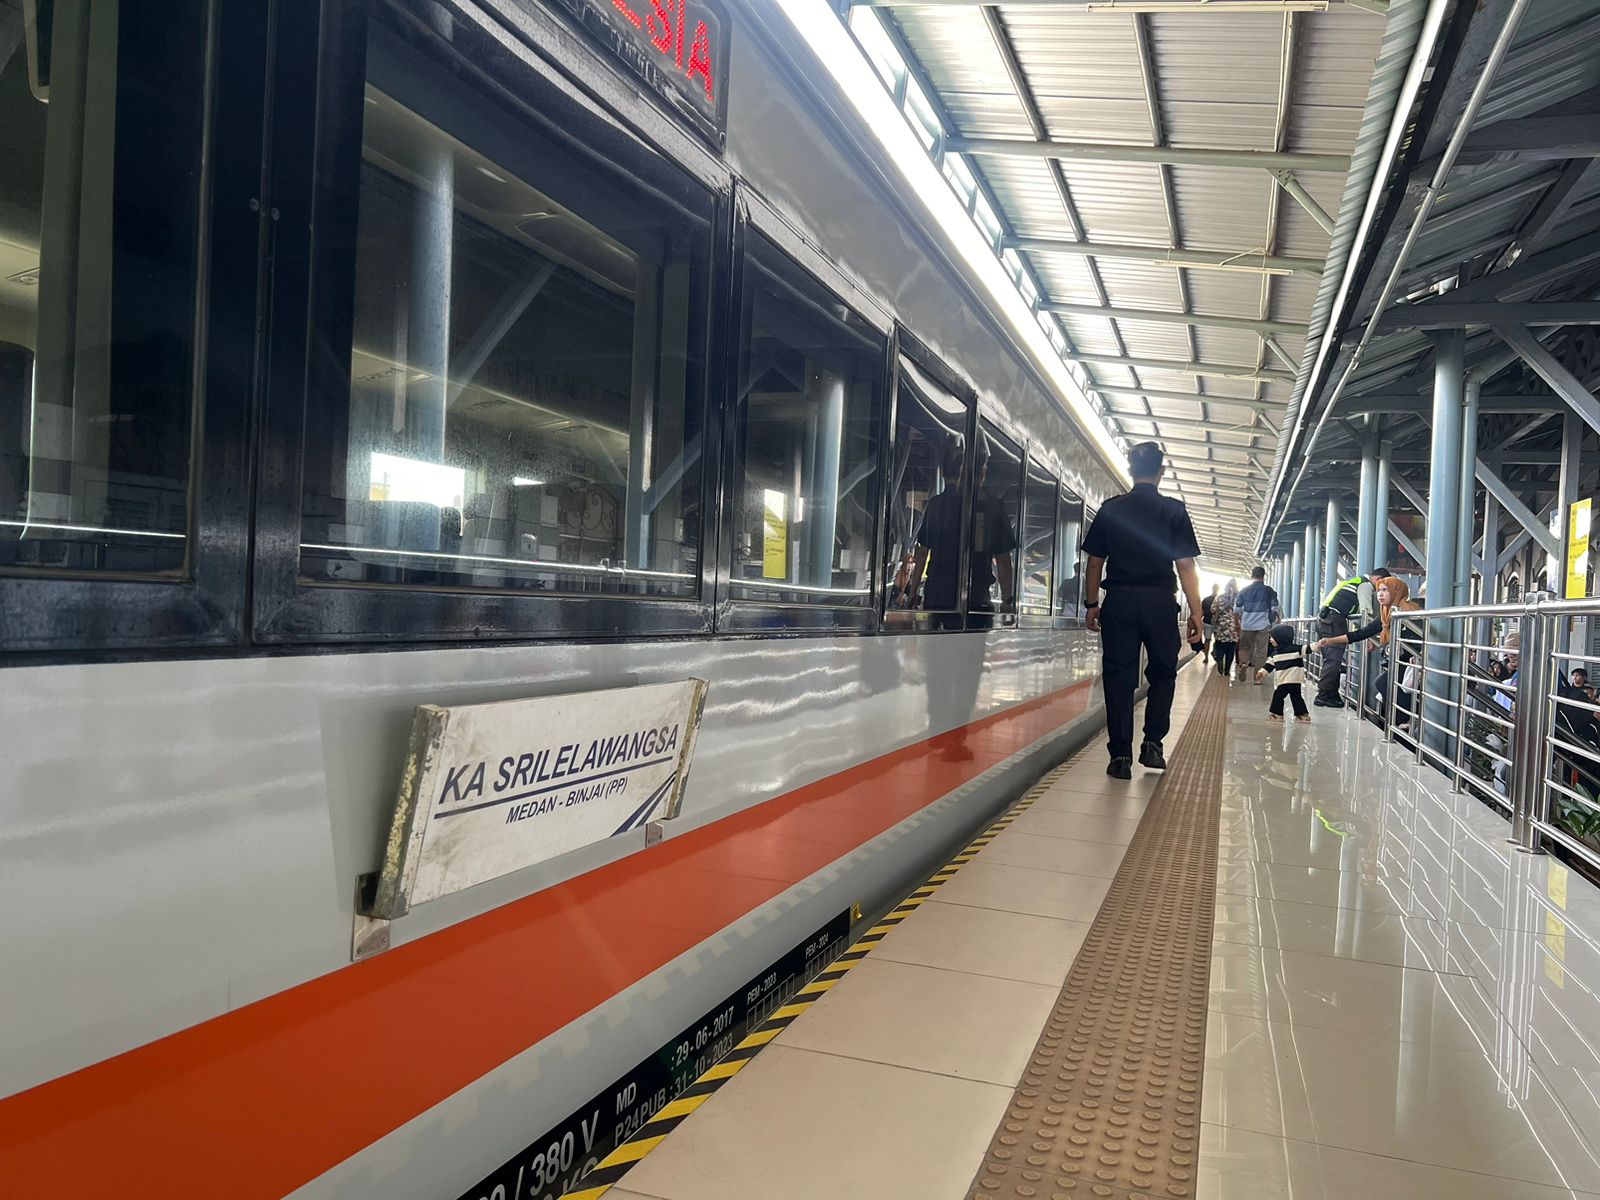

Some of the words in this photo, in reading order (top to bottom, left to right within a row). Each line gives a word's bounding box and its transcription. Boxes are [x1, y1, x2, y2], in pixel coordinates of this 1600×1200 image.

[611, 0, 713, 102] SIA
[438, 762, 485, 805] KA
[493, 724, 680, 793] SRILELAWANGSA
[505, 795, 558, 824] MEDAN
[565, 782, 606, 807] BINJAI
[605, 777, 628, 799] (PP)
[616, 1082, 637, 1115] MD
[529, 1131, 575, 1197] 380
[581, 1109, 600, 1154] V
